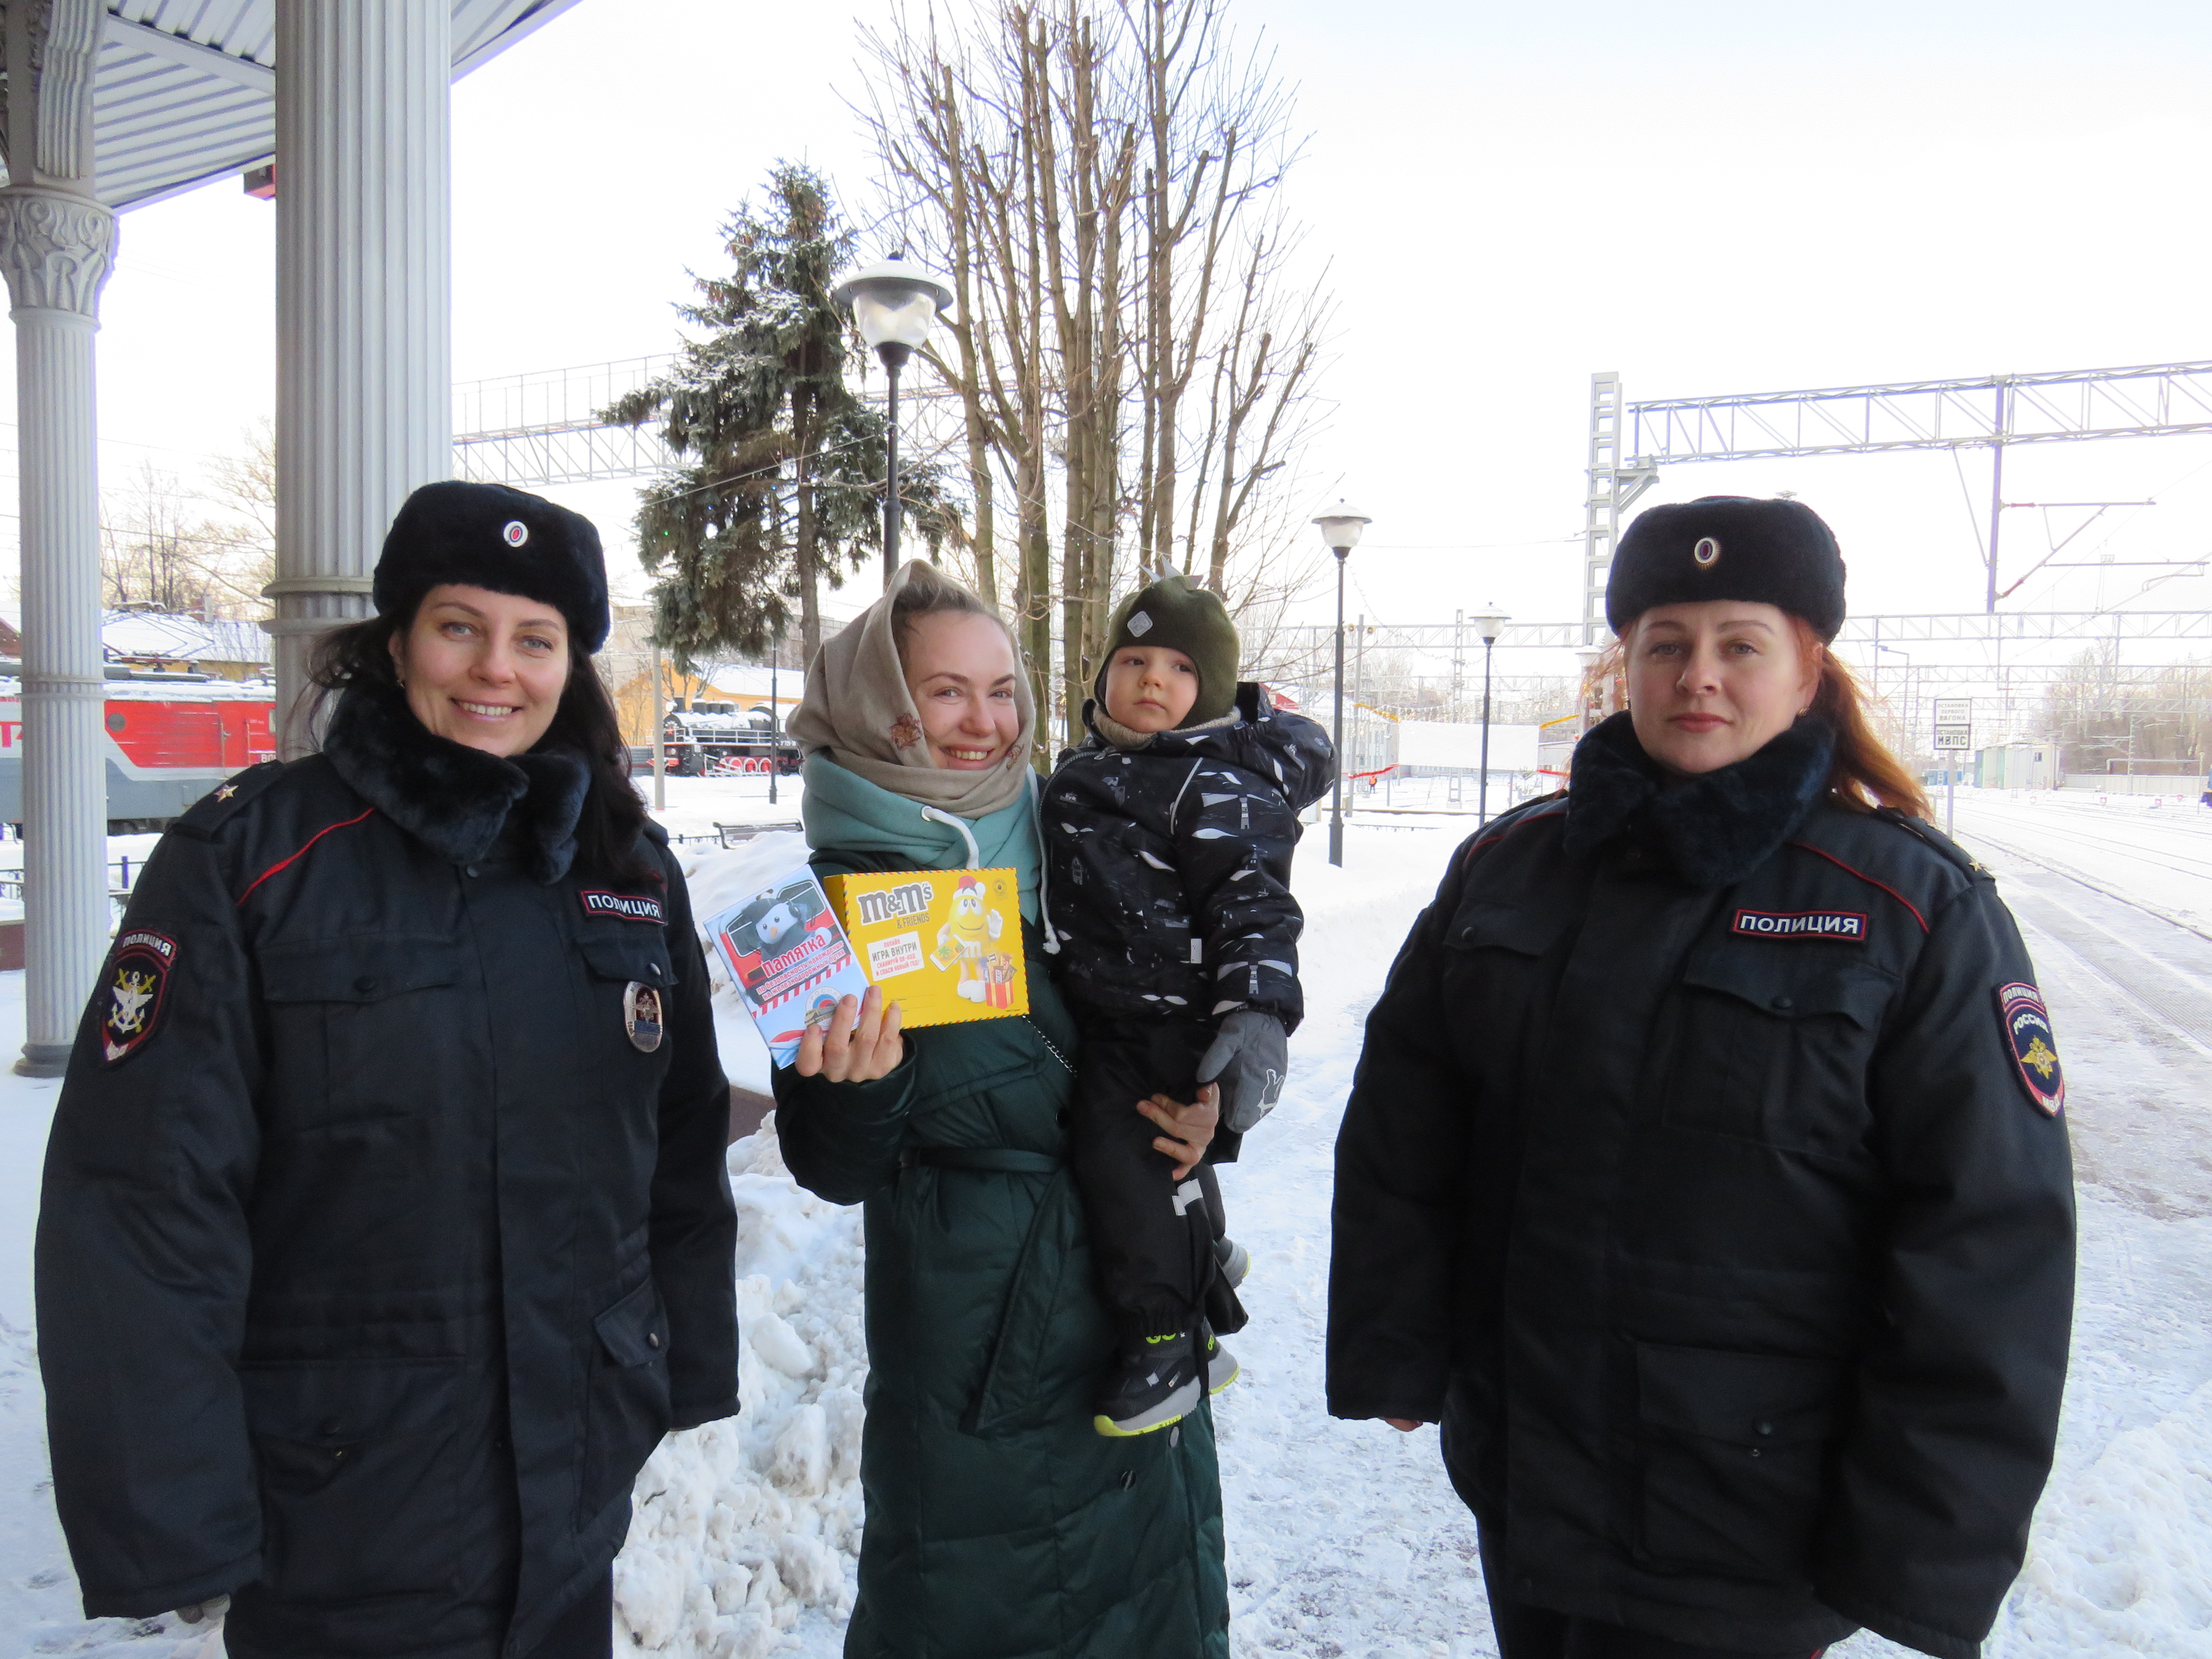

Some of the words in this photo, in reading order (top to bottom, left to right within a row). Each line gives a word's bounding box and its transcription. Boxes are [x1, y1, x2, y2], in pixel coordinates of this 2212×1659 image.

[1938, 736, 1966, 745] МВПС
[588, 895, 661, 918] ПОЛИЦИЯ
[902, 912, 930, 928] FRIENDS
[1740, 915, 1859, 934] ПОЛИЦИЯ
[122, 933, 172, 957] ПОЛИЦИЯ
[872, 949, 890, 962] ИГРА
[891, 941, 917, 957] ВНУТРИ
[883, 938, 901, 948] ОНЛАЙН
[765, 963, 808, 990] безопасности
[808, 941, 844, 966] нахождения
[771, 960, 829, 995] железнодорожных
[829, 949, 846, 963] путях
[877, 957, 899, 969] СКАНИРУЙ
[880, 966, 894, 975] СПАСИ
[894, 961, 909, 971] НОВЫЙ
[2002, 986, 2039, 1004] ПОЛИЦИЯ
[2013, 1013, 2049, 1036] РОССИЯ
